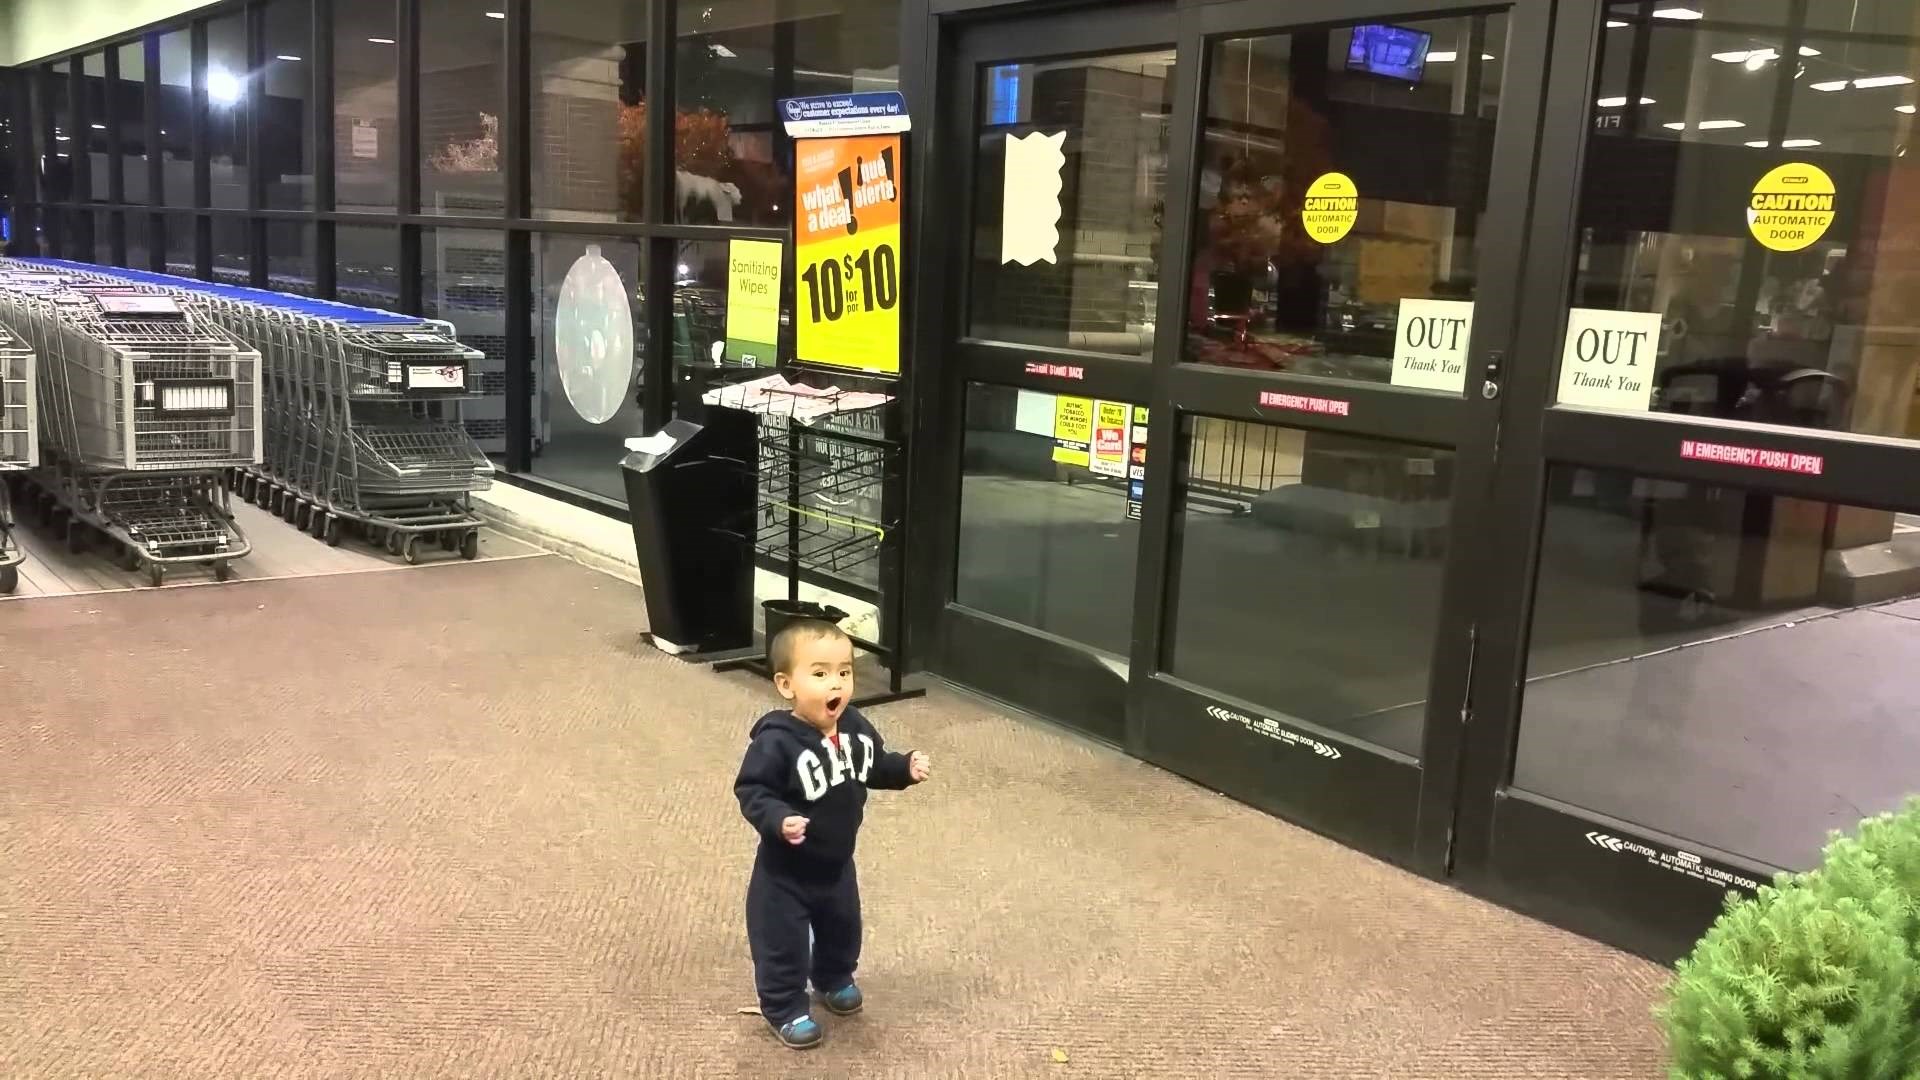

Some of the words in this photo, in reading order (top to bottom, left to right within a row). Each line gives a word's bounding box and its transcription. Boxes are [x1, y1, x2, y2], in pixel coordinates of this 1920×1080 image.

[803, 109, 831, 118] customer
[831, 105, 869, 118] expectations
[870, 106, 886, 115] every
[802, 179, 841, 211] what
[1304, 197, 1357, 211] CAUTION
[1752, 194, 1834, 211] CAUTION
[808, 212, 818, 233] a
[1306, 214, 1353, 223] AUTOMATIC
[1753, 215, 1826, 226] AUTOMATIC
[1316, 225, 1339, 234] DOOR
[1769, 229, 1805, 240] DOOR
[732, 259, 778, 281] Sanitizing
[739, 278, 768, 296] Wipes
[802, 258, 844, 324] 10
[845, 290, 858, 303] for
[846, 303, 859, 315] por
[1406, 316, 1467, 351] OUT
[1576, 327, 1648, 367] OUT
[1404, 356, 1438, 372] Thank
[1440, 359, 1462, 374] You
[1572, 371, 1613, 389] Thank
[1617, 376, 1642, 392] You
[1260, 391, 1269, 404] IN
[1268, 392, 1308, 409] EMERGENCY
[1308, 397, 1328, 412] PUSH
[1328, 400, 1349, 415] OPEN
[1682, 440, 1695, 457] IN
[1695, 442, 1759, 465] EMERGENCY
[1759, 449, 1790, 469] PUSH
[1790, 453, 1821, 474] OPEN
[797, 732, 874, 801] GAP
[1660, 852, 1703, 873] AUTOMATIC
[1703, 866, 1733, 883] SLIDING
[1734, 875, 1757, 890] DOOR
